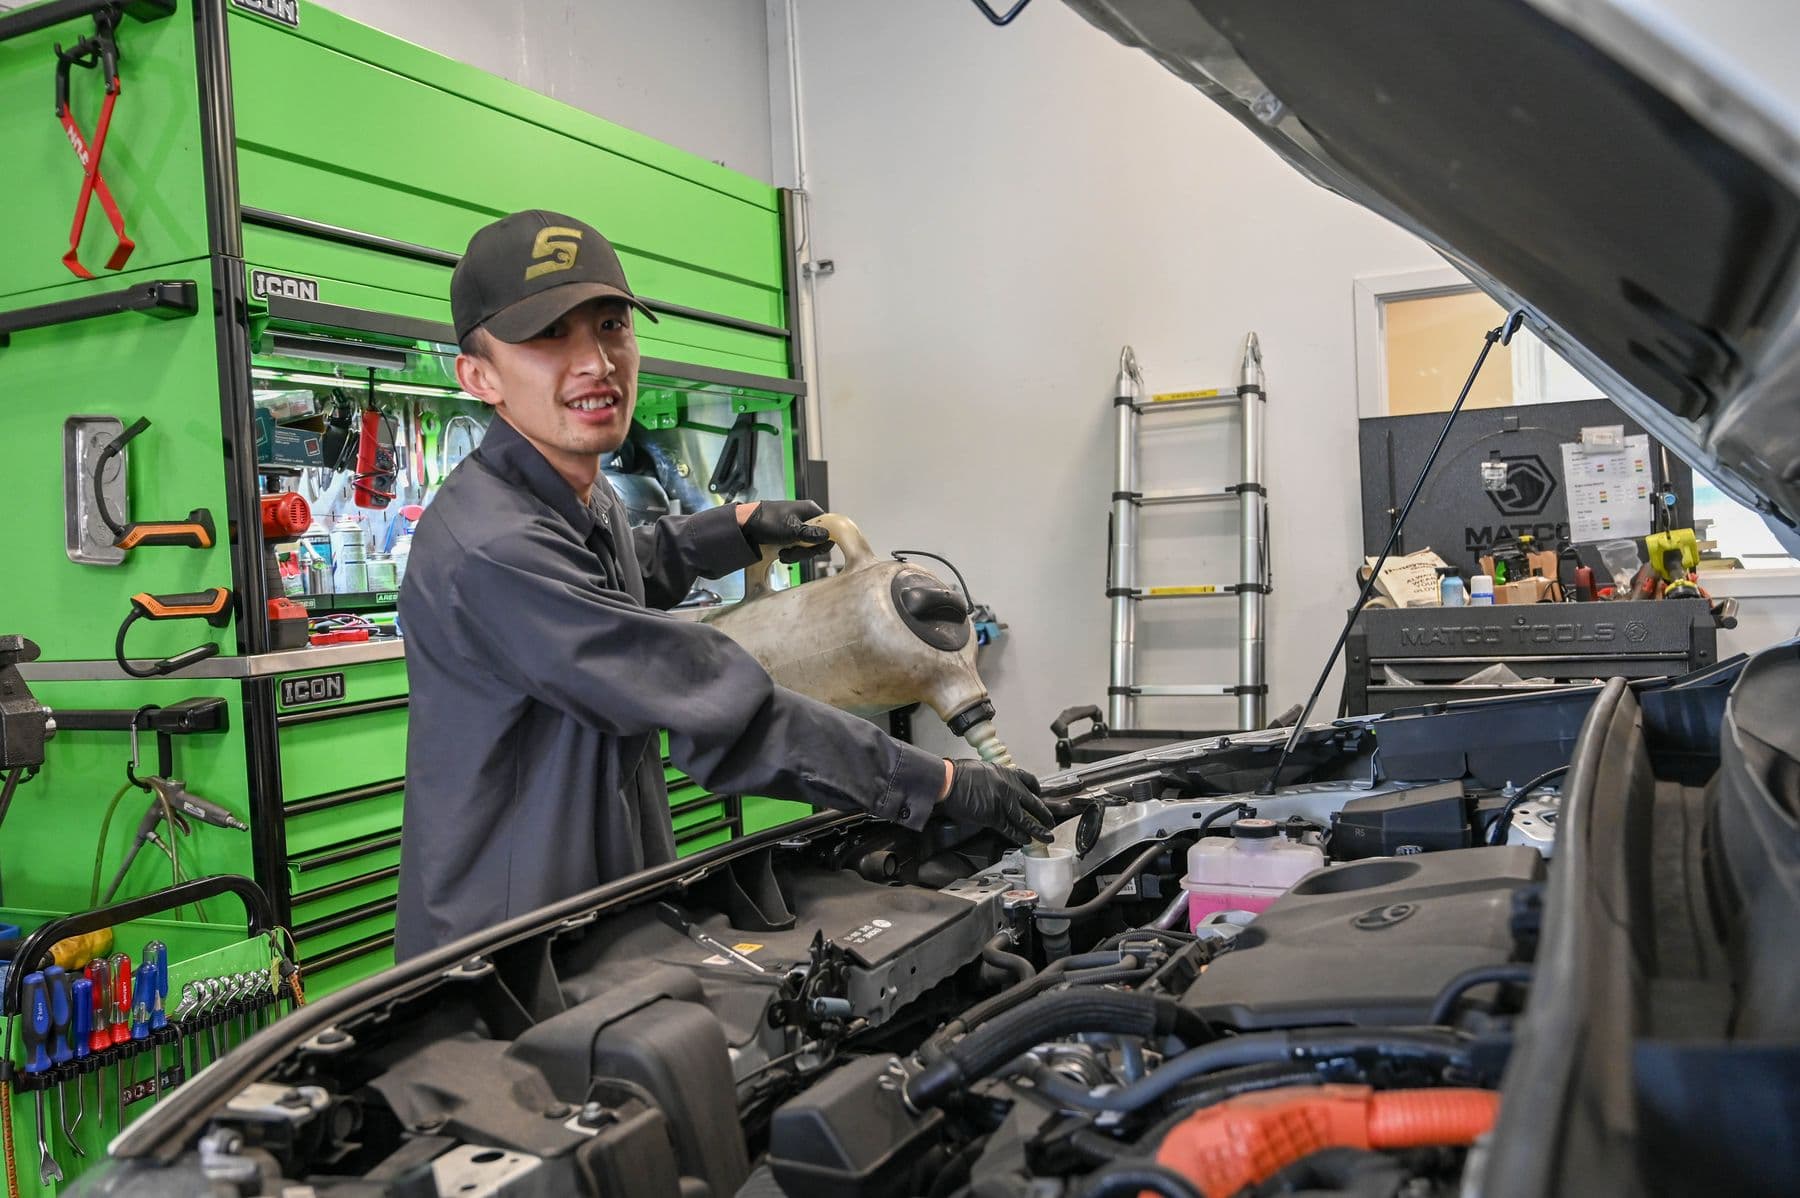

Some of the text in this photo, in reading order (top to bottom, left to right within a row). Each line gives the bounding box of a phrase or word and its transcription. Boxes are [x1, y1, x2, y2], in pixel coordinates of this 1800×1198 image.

[256, 274, 315, 301] ICON
[1401, 622, 1616, 647] MATCO TOOLS
[284, 676, 342, 703] ICON
